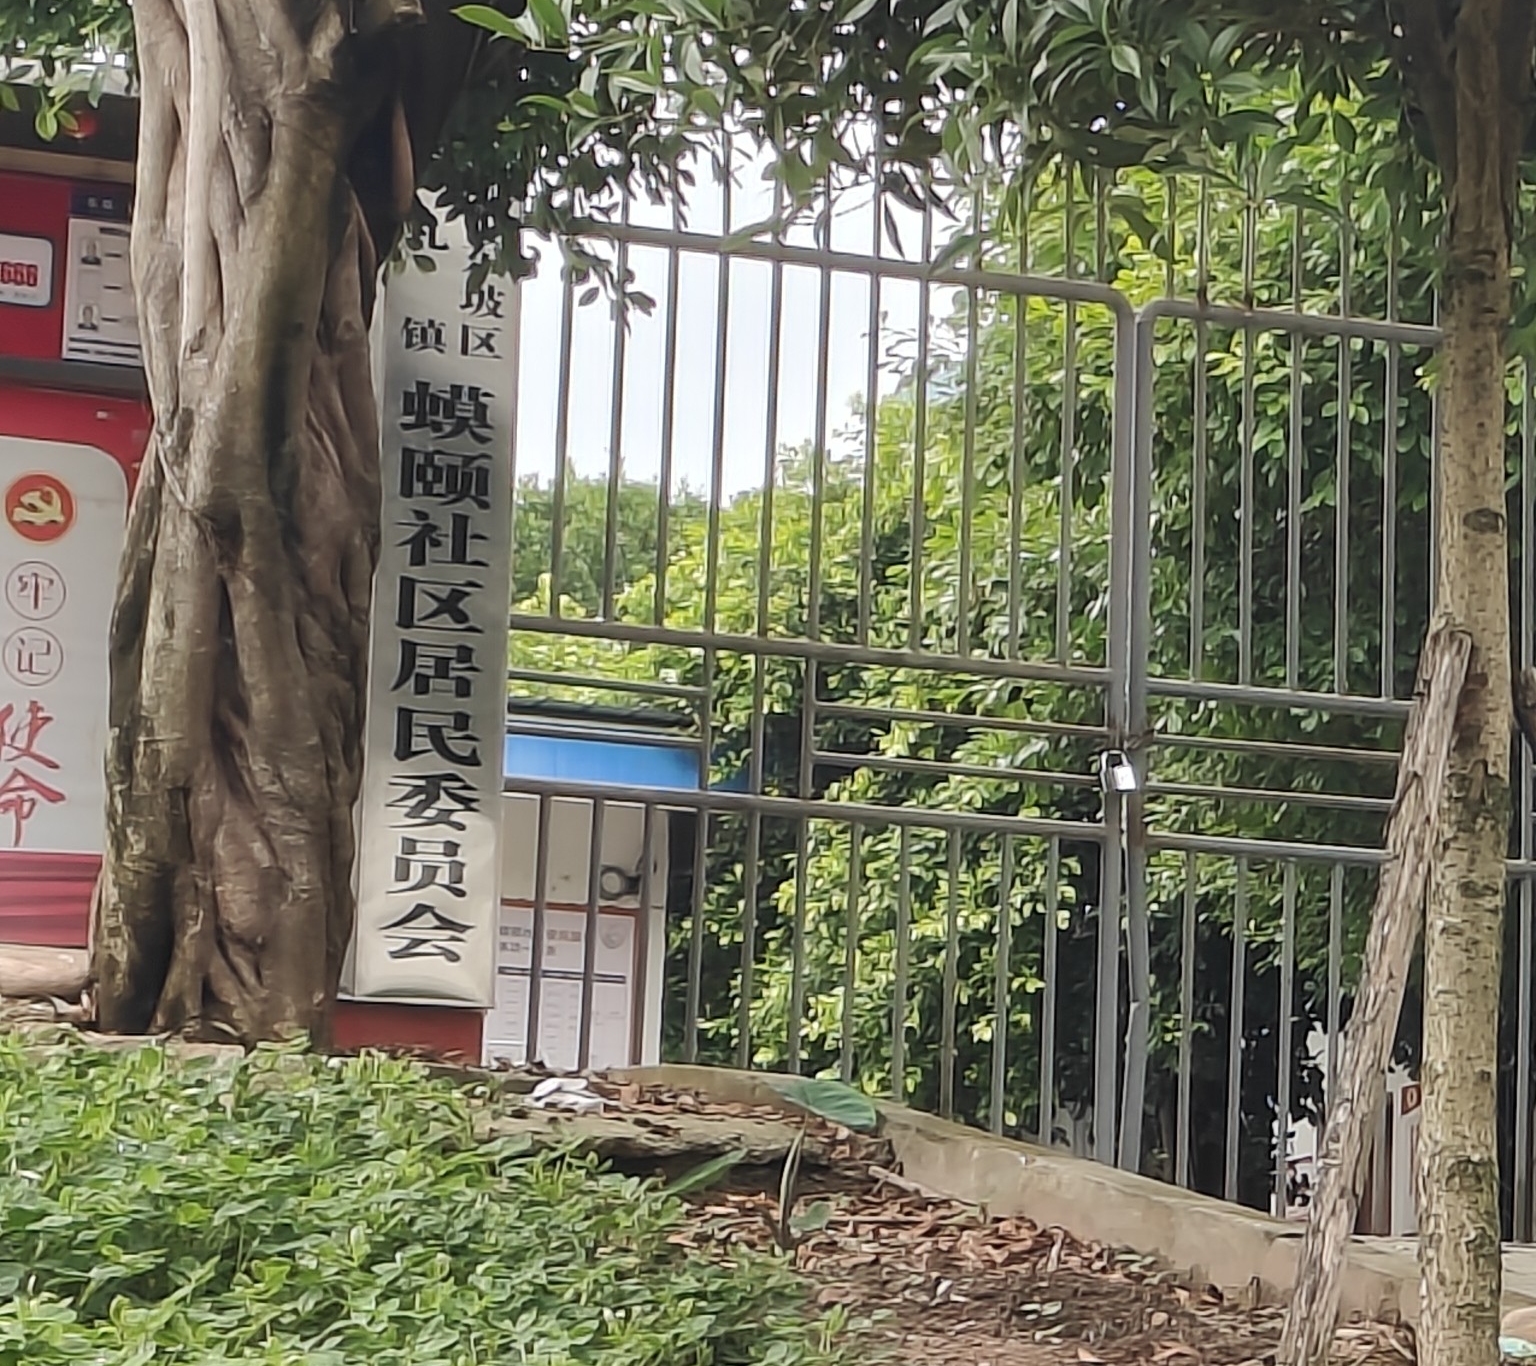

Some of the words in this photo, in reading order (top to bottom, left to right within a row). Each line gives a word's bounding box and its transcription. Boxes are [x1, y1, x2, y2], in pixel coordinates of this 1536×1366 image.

[379, 380, 495, 963] 蟆颐社区居民委员会
